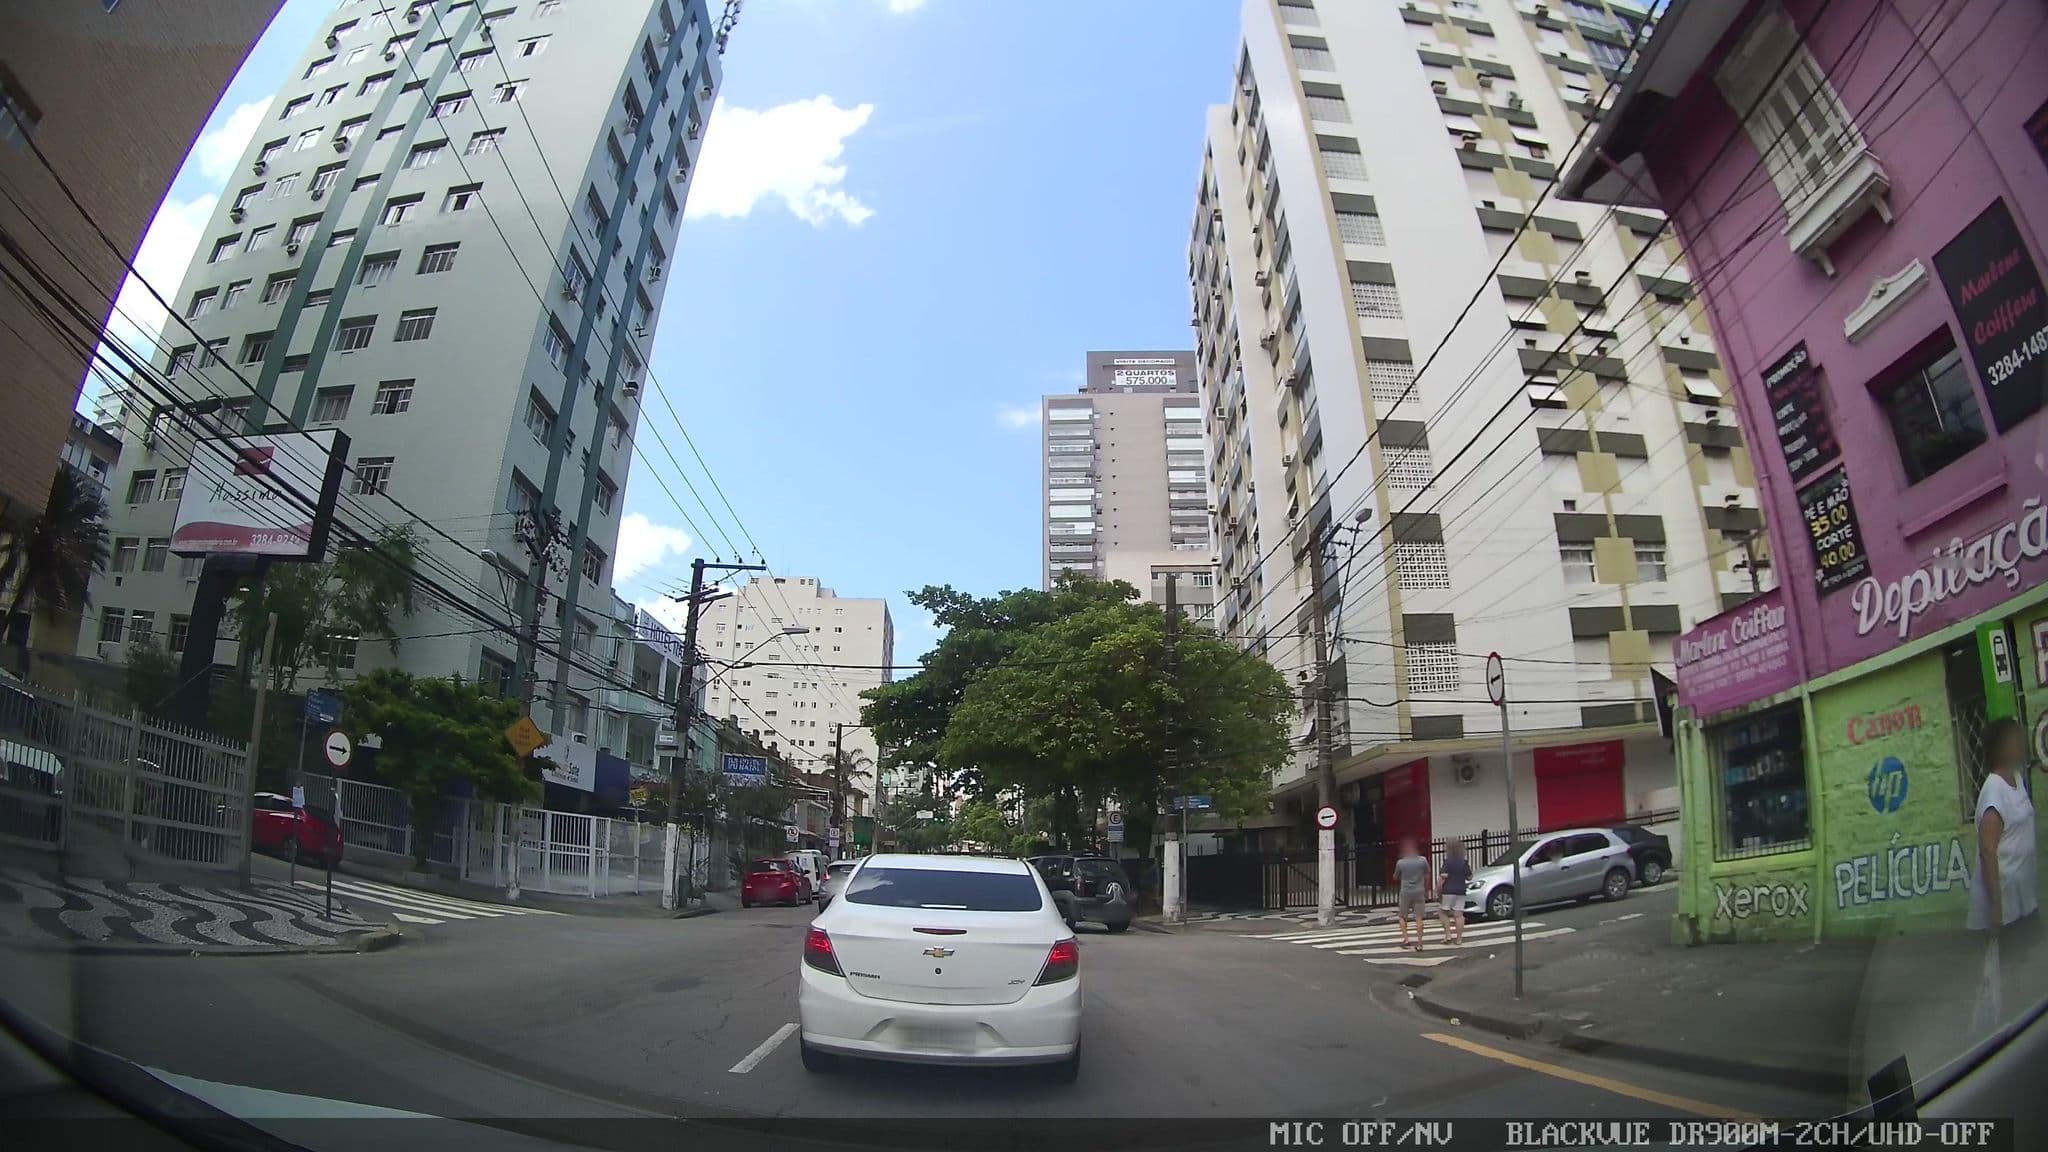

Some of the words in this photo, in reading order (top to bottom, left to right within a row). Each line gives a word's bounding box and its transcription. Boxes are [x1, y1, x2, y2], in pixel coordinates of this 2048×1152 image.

[1126, 376, 1168, 385] 575.000
[1816, 524, 1853, 551] CORTE
[1847, 704, 1922, 746] Canon
[1869, 757, 1908, 814] hp
[1834, 832, 1972, 909] PELÍCULA
